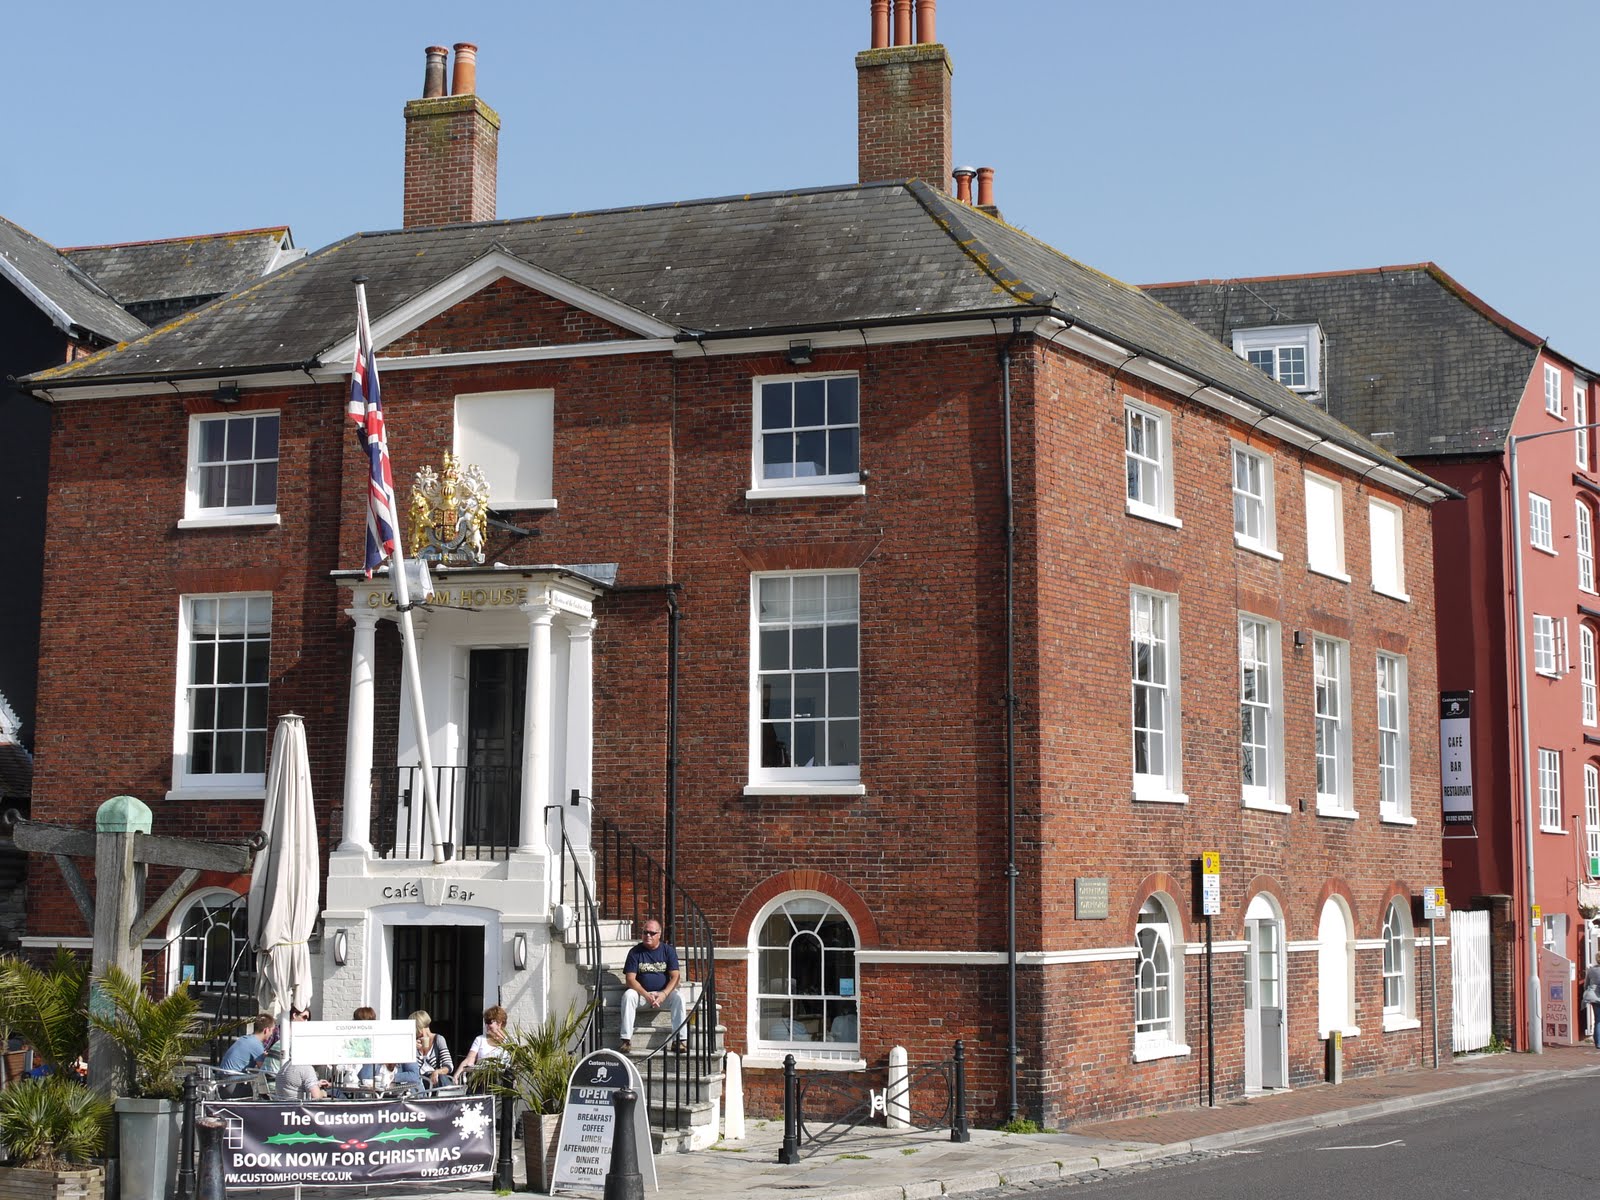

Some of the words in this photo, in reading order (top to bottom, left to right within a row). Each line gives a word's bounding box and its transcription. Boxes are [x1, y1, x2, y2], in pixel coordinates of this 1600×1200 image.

[367, 590, 451, 608] CUM
[460, 588, 529, 606] HOUSE
[1448, 734, 1462, 748] CAFÉ
[1450, 761, 1462, 772] BAR
[1444, 785, 1472, 797] RESTAURANT
[383, 882, 419, 899] Café
[448, 885, 475, 901] Bar
[1546, 1003, 1567, 1012] PIZZA
[1545, 1013, 1568, 1021] PASTA
[579, 1089, 608, 1100] OPEN
[281, 1111, 311, 1126] The
[314, 1111, 374, 1126] Custom
[378, 1110, 427, 1124] House
[577, 1113, 612, 1122] BREAKFAST
[582, 1124, 605, 1133] COFFEE
[581, 1135, 602, 1143] LUNCH
[563, 1144, 600, 1154] AFTERNOON
[233, 1153, 282, 1168] BOOK
[286, 1152, 328, 1167] NOW
[331, 1151, 365, 1166] FOR
[368, 1146, 462, 1165] CHRISTMAS
[575, 1155, 600, 1165] DINNER
[421, 1167, 449, 1177] 01202
[450, 1164, 485, 1175] 676767
[569, 1166, 604, 1176] COCKTAILS
[224, 1171, 353, 1183] W.CUSTOMHOUSE.CO.UK
